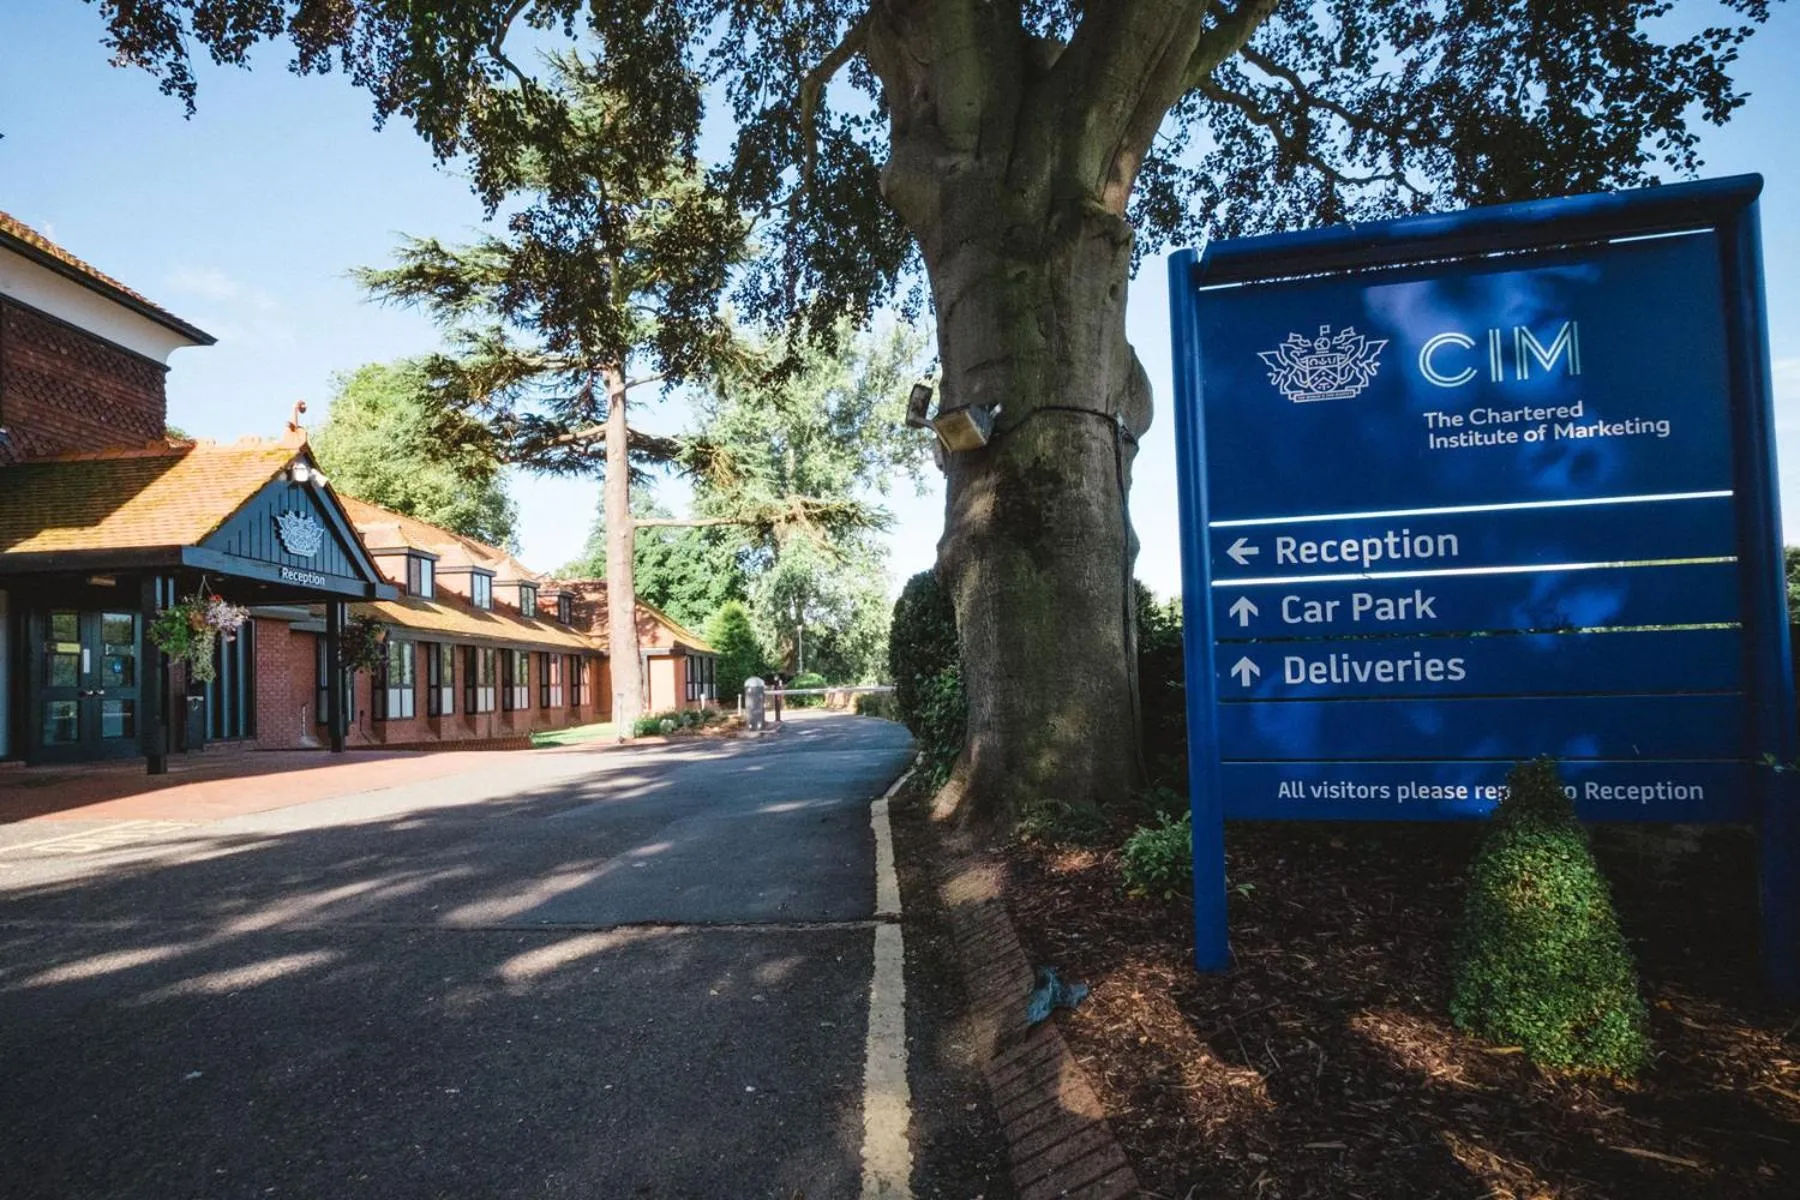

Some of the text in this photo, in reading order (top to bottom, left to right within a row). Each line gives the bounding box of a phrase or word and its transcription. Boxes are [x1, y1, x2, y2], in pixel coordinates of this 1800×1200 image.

[1418, 321, 1582, 388] CIM
[1423, 399, 1584, 430] The Chartered
[1429, 416, 1671, 450] Institute of Marketing
[1276, 529, 1459, 569] Reception
[282, 567, 326, 585] Reception
[1281, 590, 1438, 624] Car Park
[1284, 651, 1466, 685] Deliveries
[1278, 780, 1704, 804] All visitors please rep o Reception
